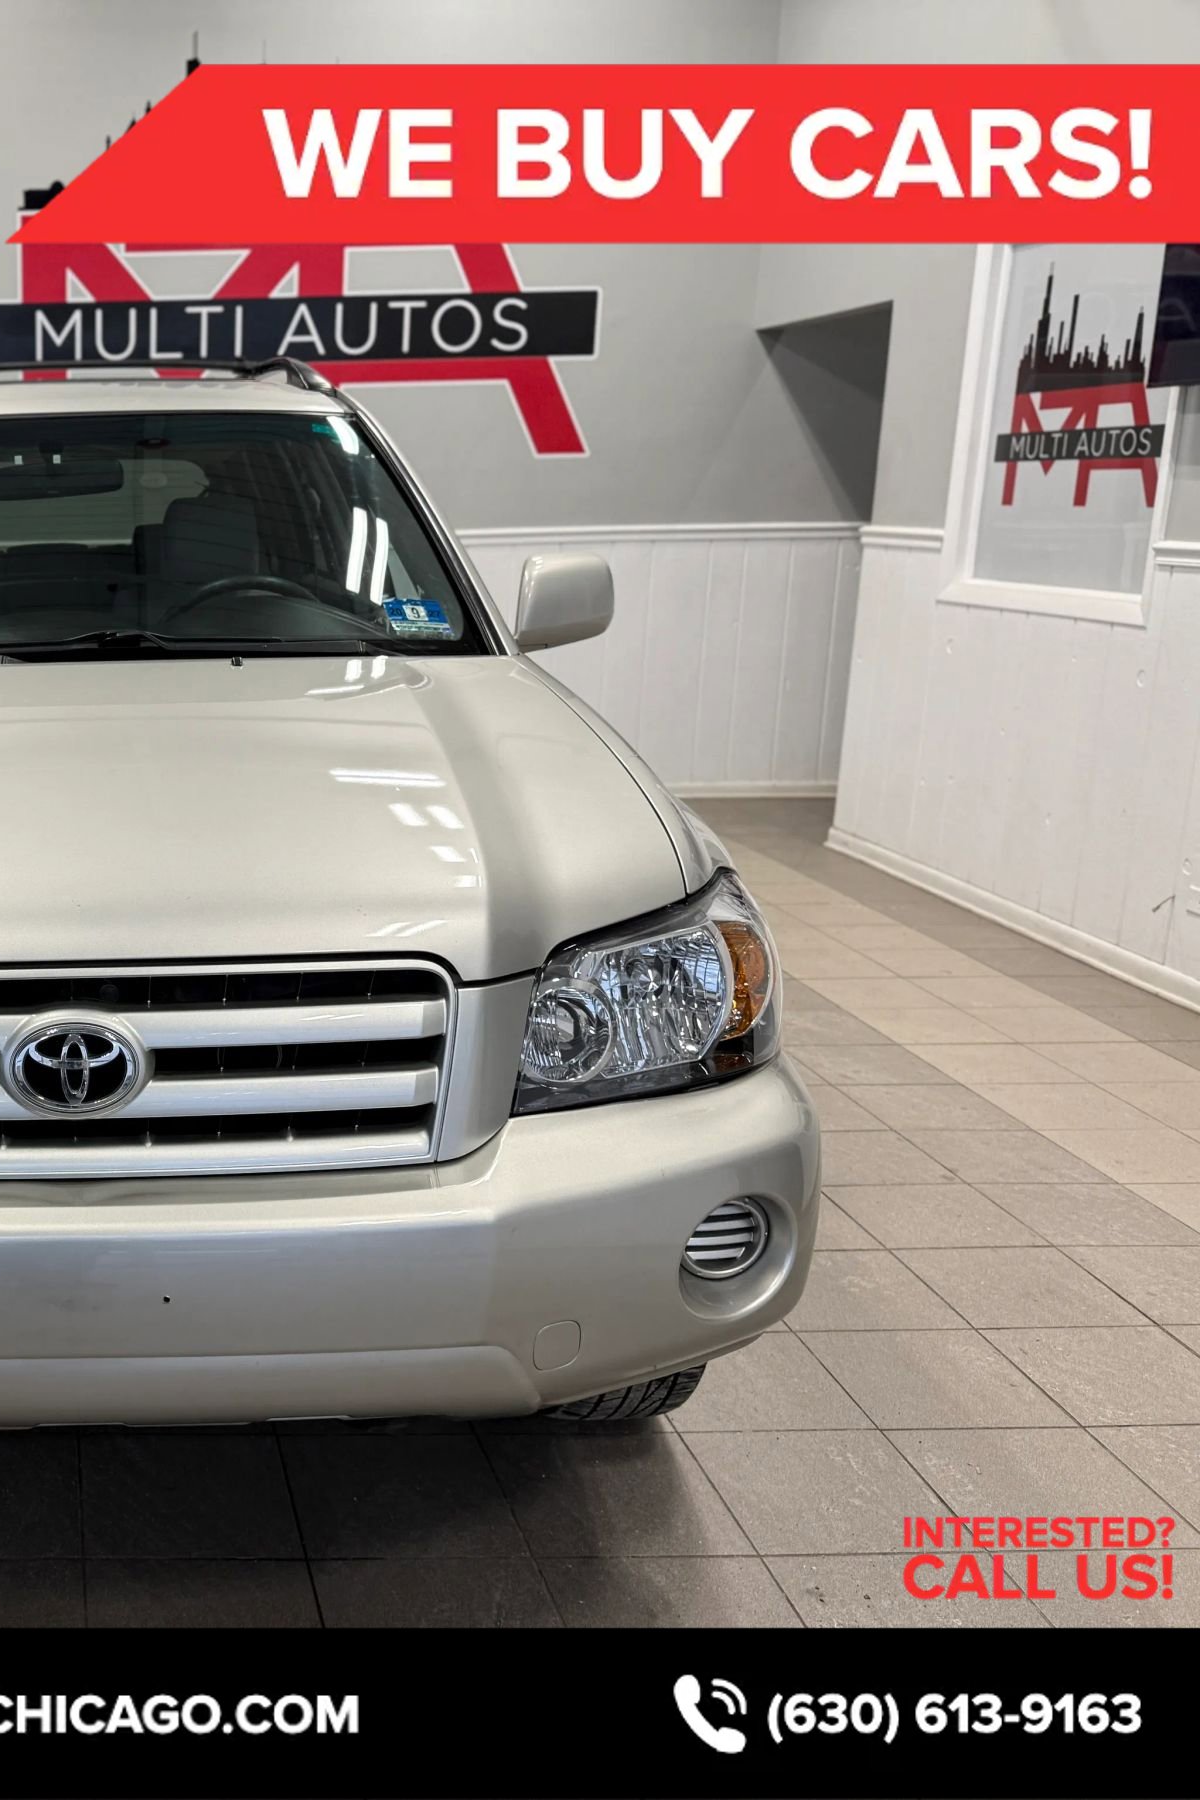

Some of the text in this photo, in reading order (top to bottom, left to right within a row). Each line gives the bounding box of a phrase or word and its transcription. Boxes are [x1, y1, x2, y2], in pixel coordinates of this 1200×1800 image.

[34, 297, 530, 361] MULTI AUTOS
[1009, 427, 1153, 459] MULTI AUTOS
[410, 607, 421, 619] 9
